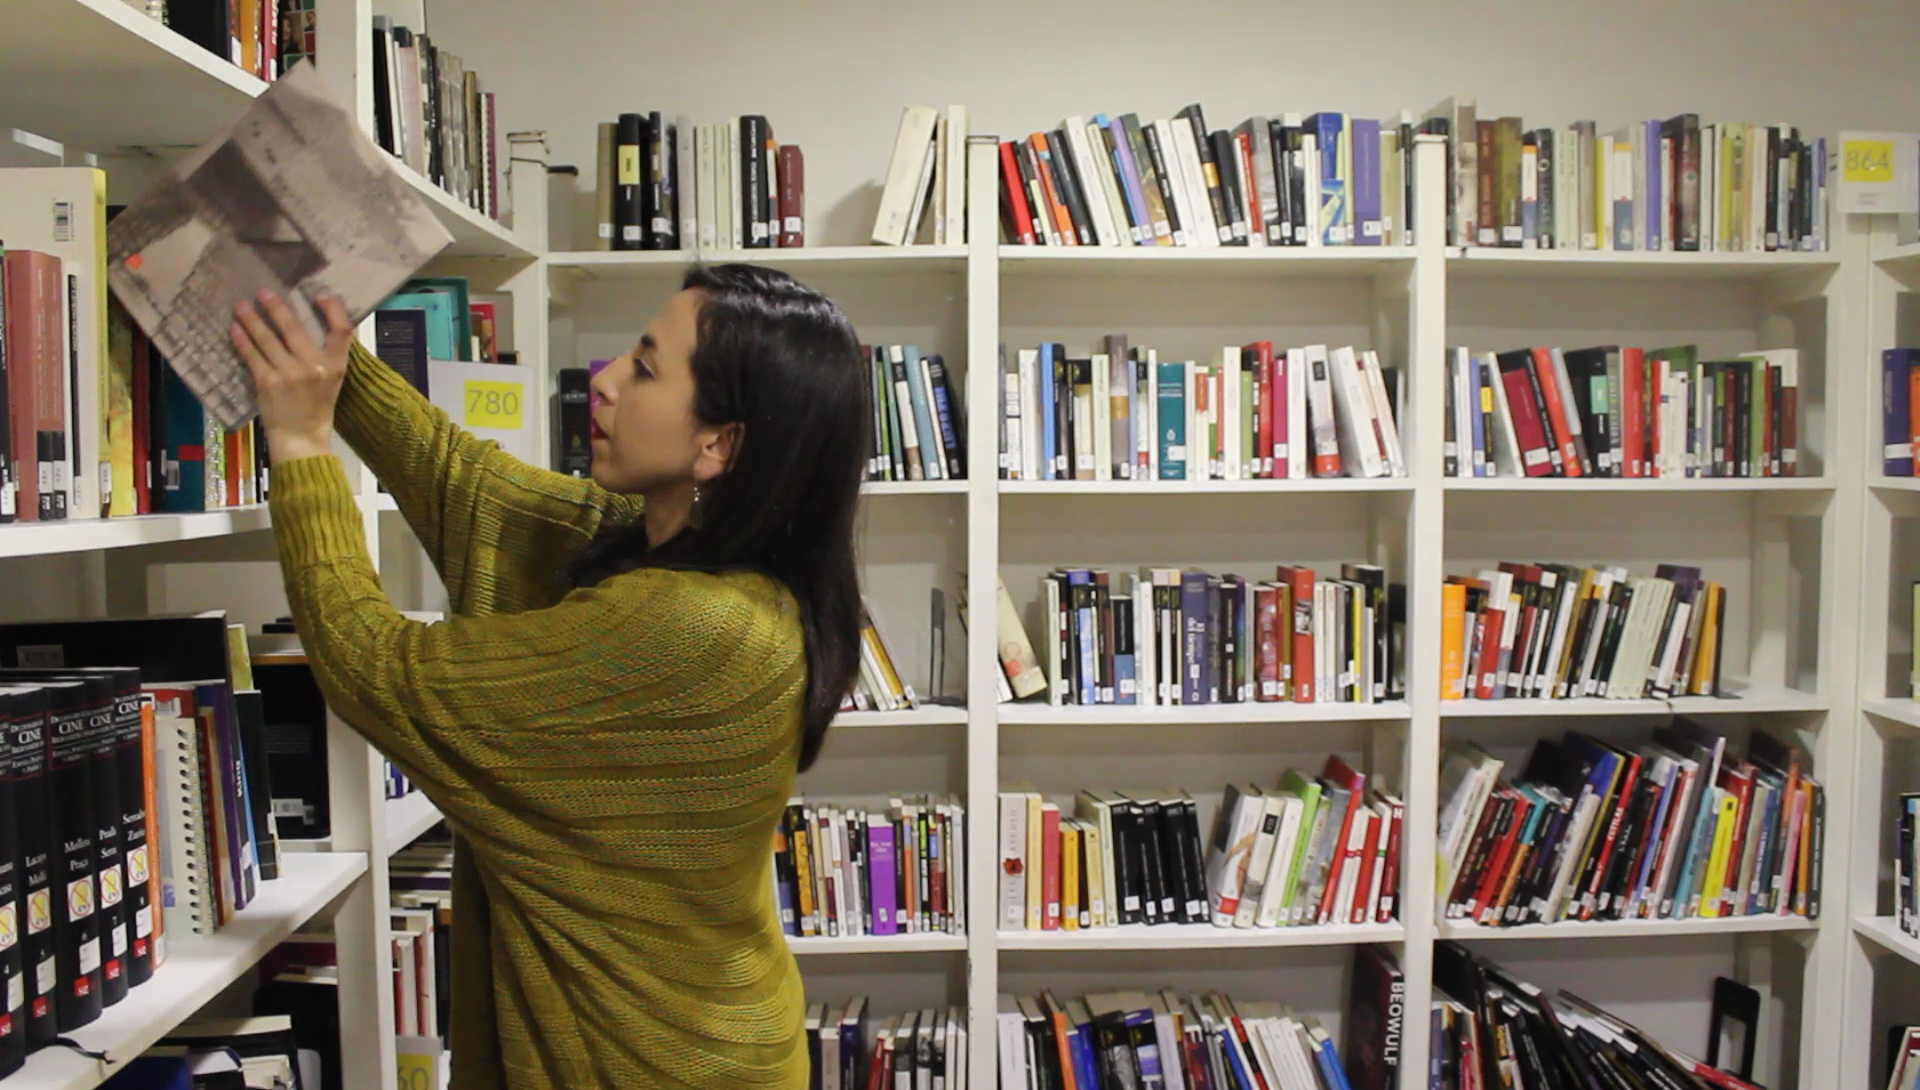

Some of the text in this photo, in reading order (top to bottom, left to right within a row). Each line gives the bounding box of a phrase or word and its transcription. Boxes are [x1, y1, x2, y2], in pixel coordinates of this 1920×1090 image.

[1846, 150, 1889, 172] 864
[468, 389, 519, 416] 780
[58, 719, 83, 735] CINE
[89, 712, 112, 728] CINE
[18, 727, 42, 745] CINE
[1383, 981, 1406, 1066] BEOWULF
